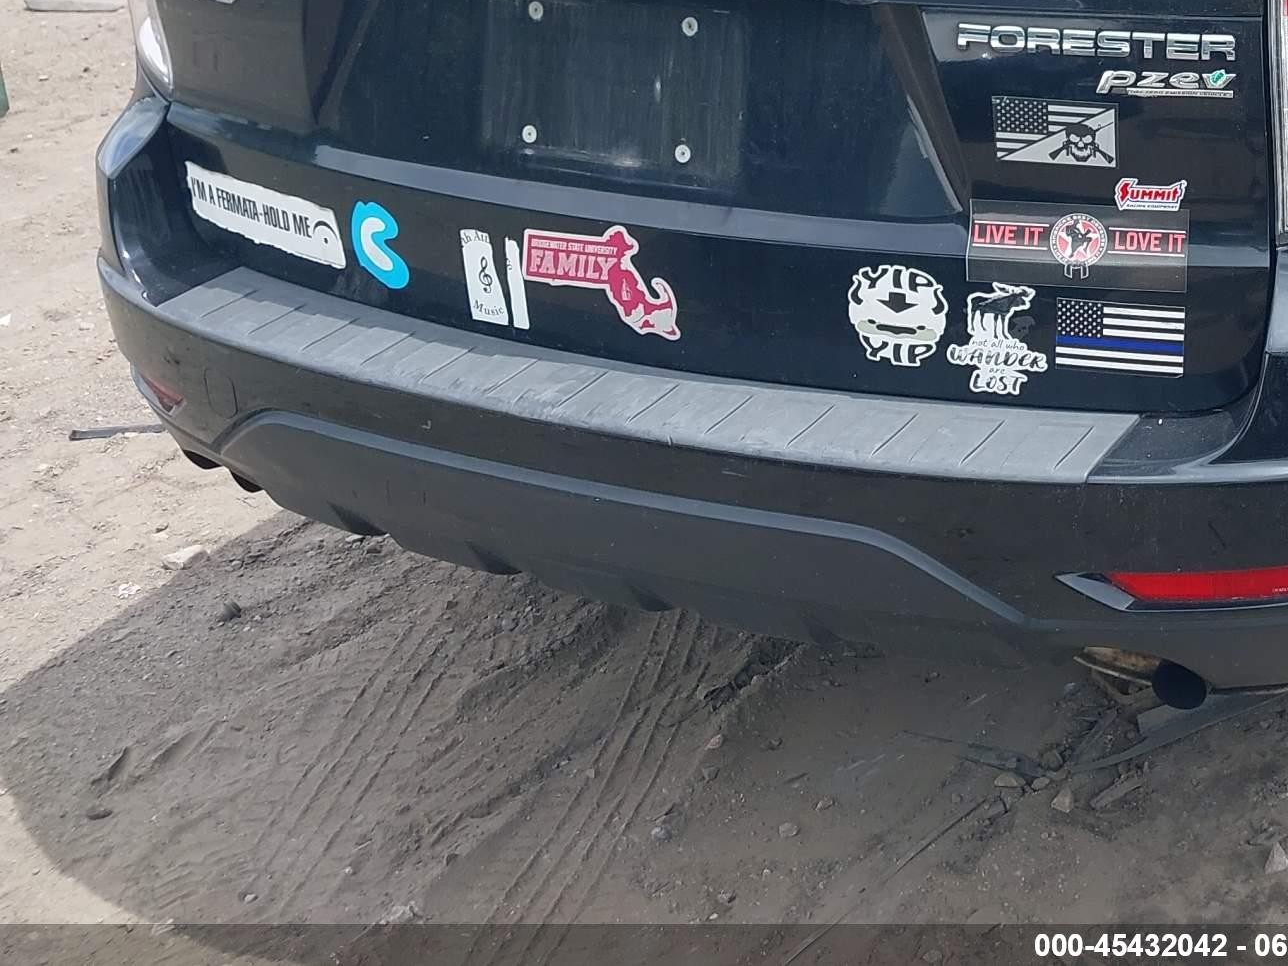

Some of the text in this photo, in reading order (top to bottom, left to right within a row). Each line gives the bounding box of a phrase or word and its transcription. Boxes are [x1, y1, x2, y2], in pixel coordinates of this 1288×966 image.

[957, 23, 1237, 61] FORESTER
[190, 177, 313, 239] I'M A FERMATA-HOLD ME
[973, 224, 1018, 245] LIVE
[1024, 227, 1044, 246] IT
[1114, 232, 1162, 252] LOVE
[1168, 234, 1186, 252] IT
[529, 248, 619, 281] FAMILY
[861, 267, 935, 293] YIP
[473, 299, 505, 316] Music
[861, 335, 935, 364] YIP
[971, 338, 1025, 351] not all who
[988, 367, 1006, 375] are
[973, 373, 1026, 392] LOST
